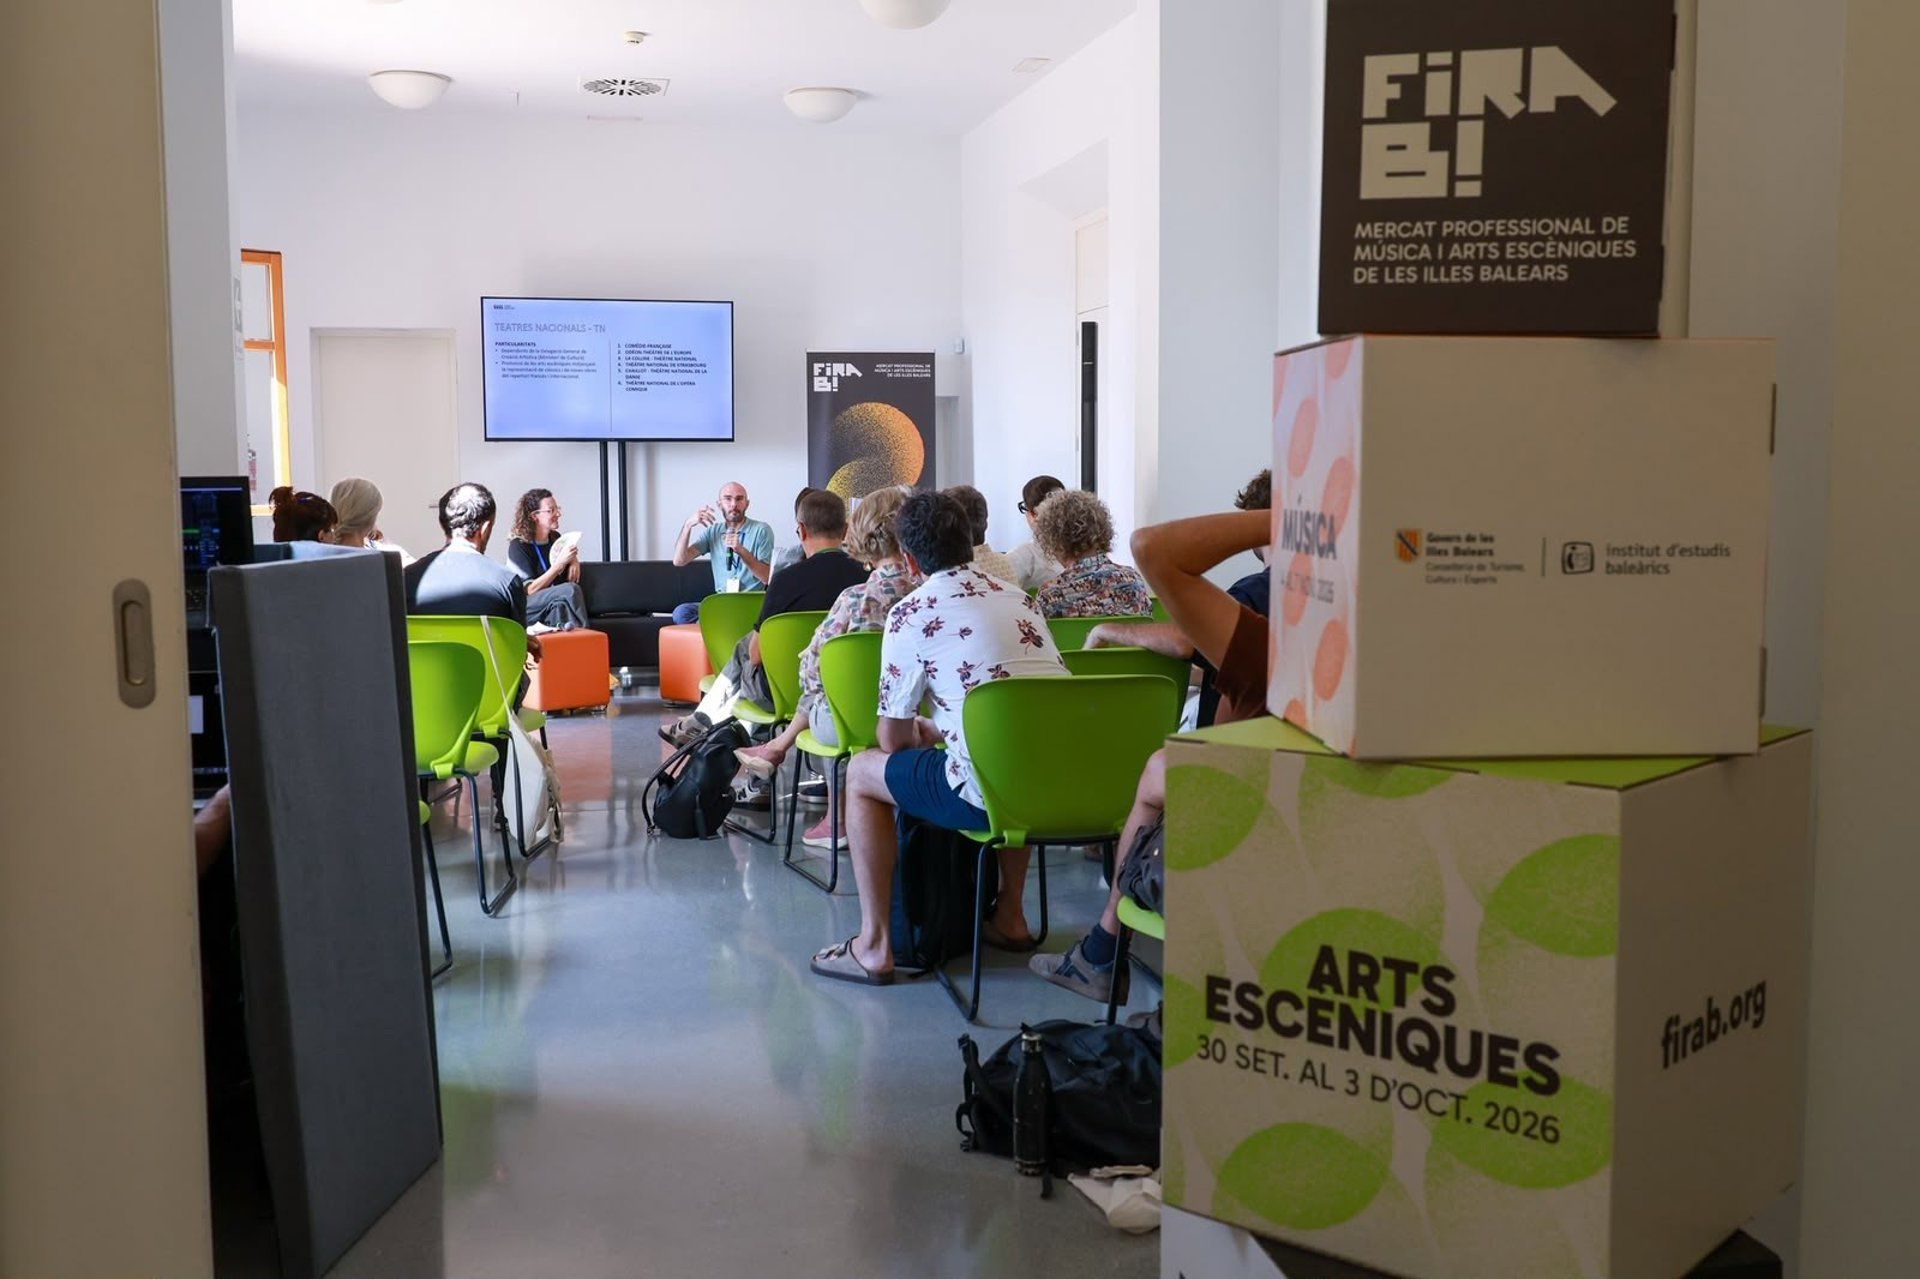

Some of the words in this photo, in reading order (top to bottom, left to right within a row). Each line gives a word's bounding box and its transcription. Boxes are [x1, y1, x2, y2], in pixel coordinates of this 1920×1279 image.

[1354, 221, 1437, 239] MERCAT
[1442, 217, 1594, 238] PROFESSIONAL
[1601, 216, 1630, 234] DE
[1354, 239, 1432, 262] MÚSICA
[1437, 243, 1443, 260] I
[1448, 242, 1500, 260] ARTS
[1505, 236, 1637, 260] ESCÈNIQUES
[1354, 267, 1378, 284] DE
[1384, 266, 1418, 284] LES
[1423, 265, 1474, 284] ILLES
[1479, 264, 1570, 282] BALEARS
[494, 323, 533, 332] TEATRES
[536, 324, 586, 332] NACIONALS
[1282, 494, 1337, 560] MÚSICA
[1426, 532, 1462, 543] Govern
[1465, 533, 1477, 543] de
[1480, 533, 1494, 543] les
[1453, 546, 1494, 557] Balears
[1606, 543, 1660, 557] institut
[1666, 543, 1731, 558] d'estudis
[1606, 560, 1671, 575] baleàrics
[1306, 944, 1457, 1018] ARTS
[1662, 980, 1766, 1070] firab.org
[1196, 1035, 1227, 1064] 30
[1234, 1044, 1290, 1080] SET.
[1299, 1059, 1336, 1092] AL
[1344, 1069, 1360, 1097] 3
[1370, 1074, 1474, 1124] D'OCT.
[1483, 1101, 1562, 1146] 2026
